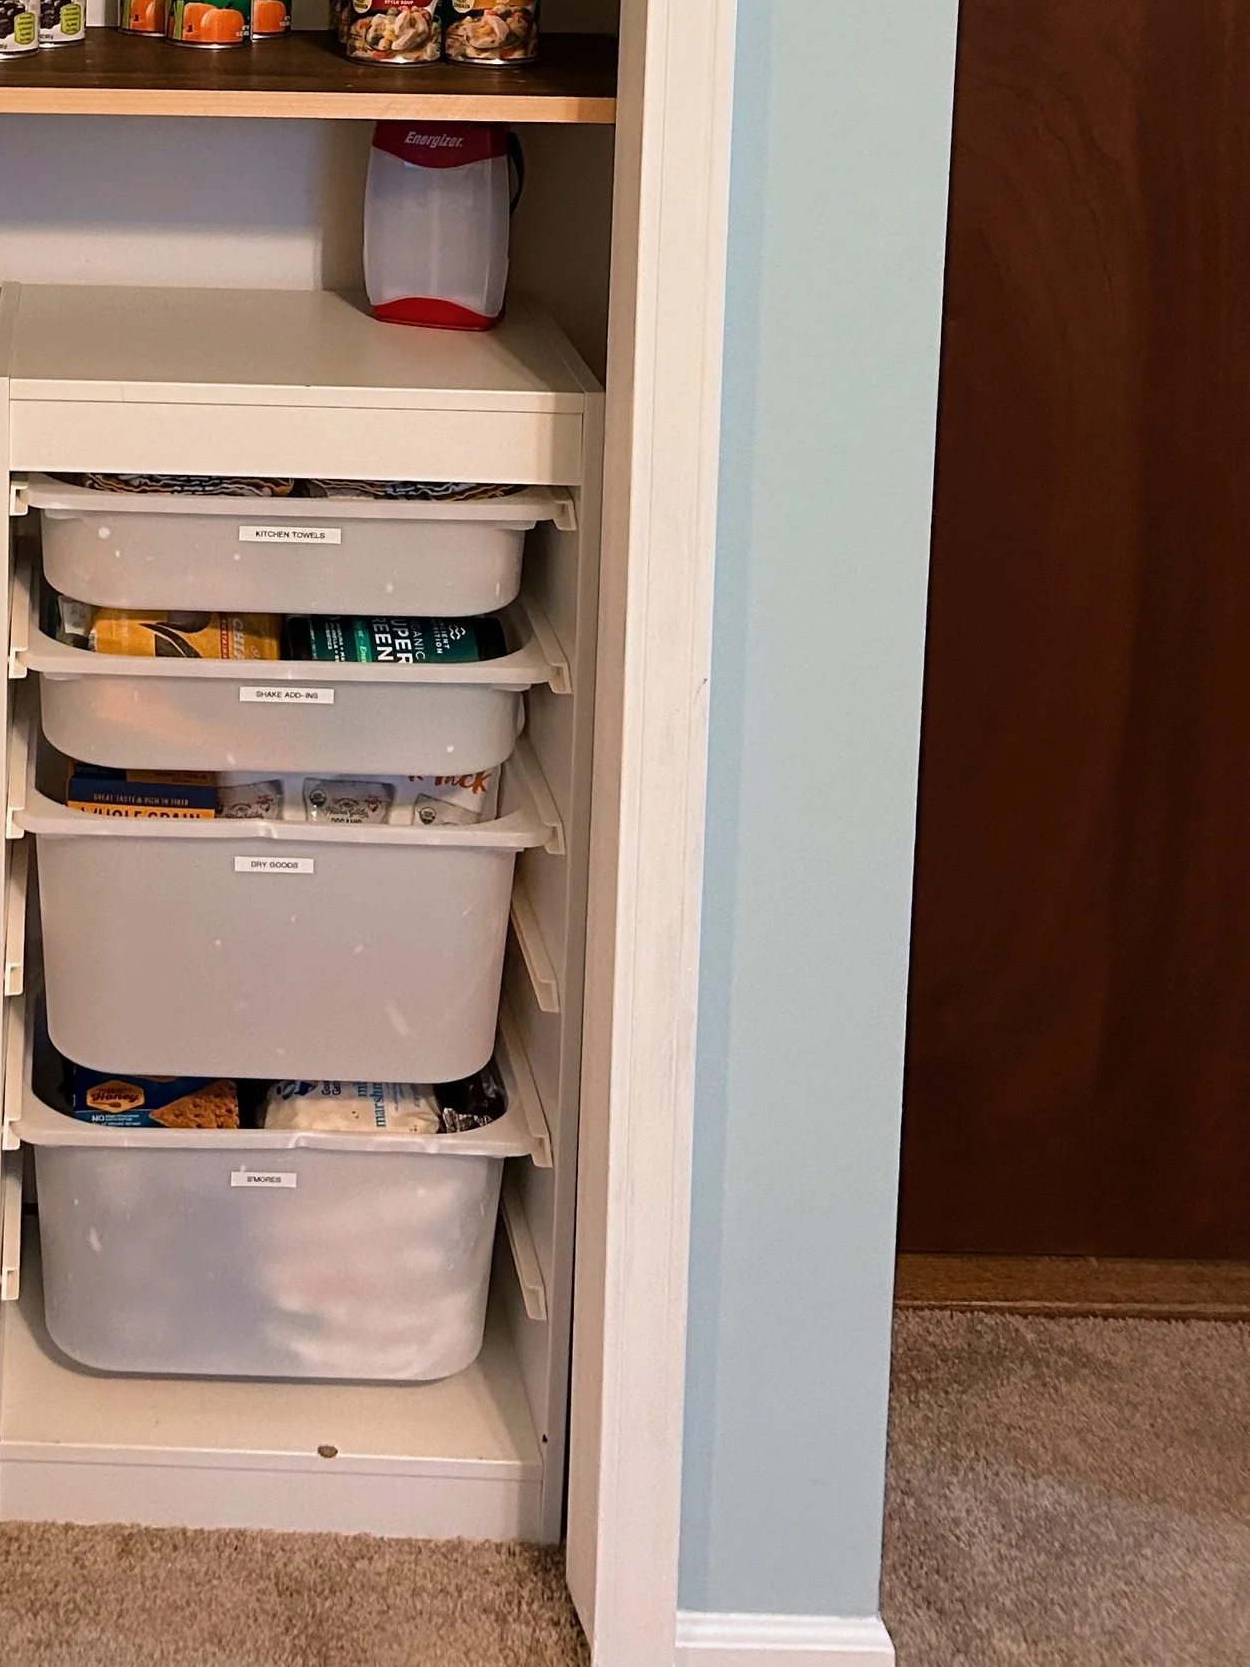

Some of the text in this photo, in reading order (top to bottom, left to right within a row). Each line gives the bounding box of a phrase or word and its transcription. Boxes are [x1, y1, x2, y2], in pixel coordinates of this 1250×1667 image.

[405, 131, 464, 148] Energizer
[292, 531, 326, 539] TOWELS
[390, 619, 413, 663] UPER
[411, 624, 426, 659] GANIC
